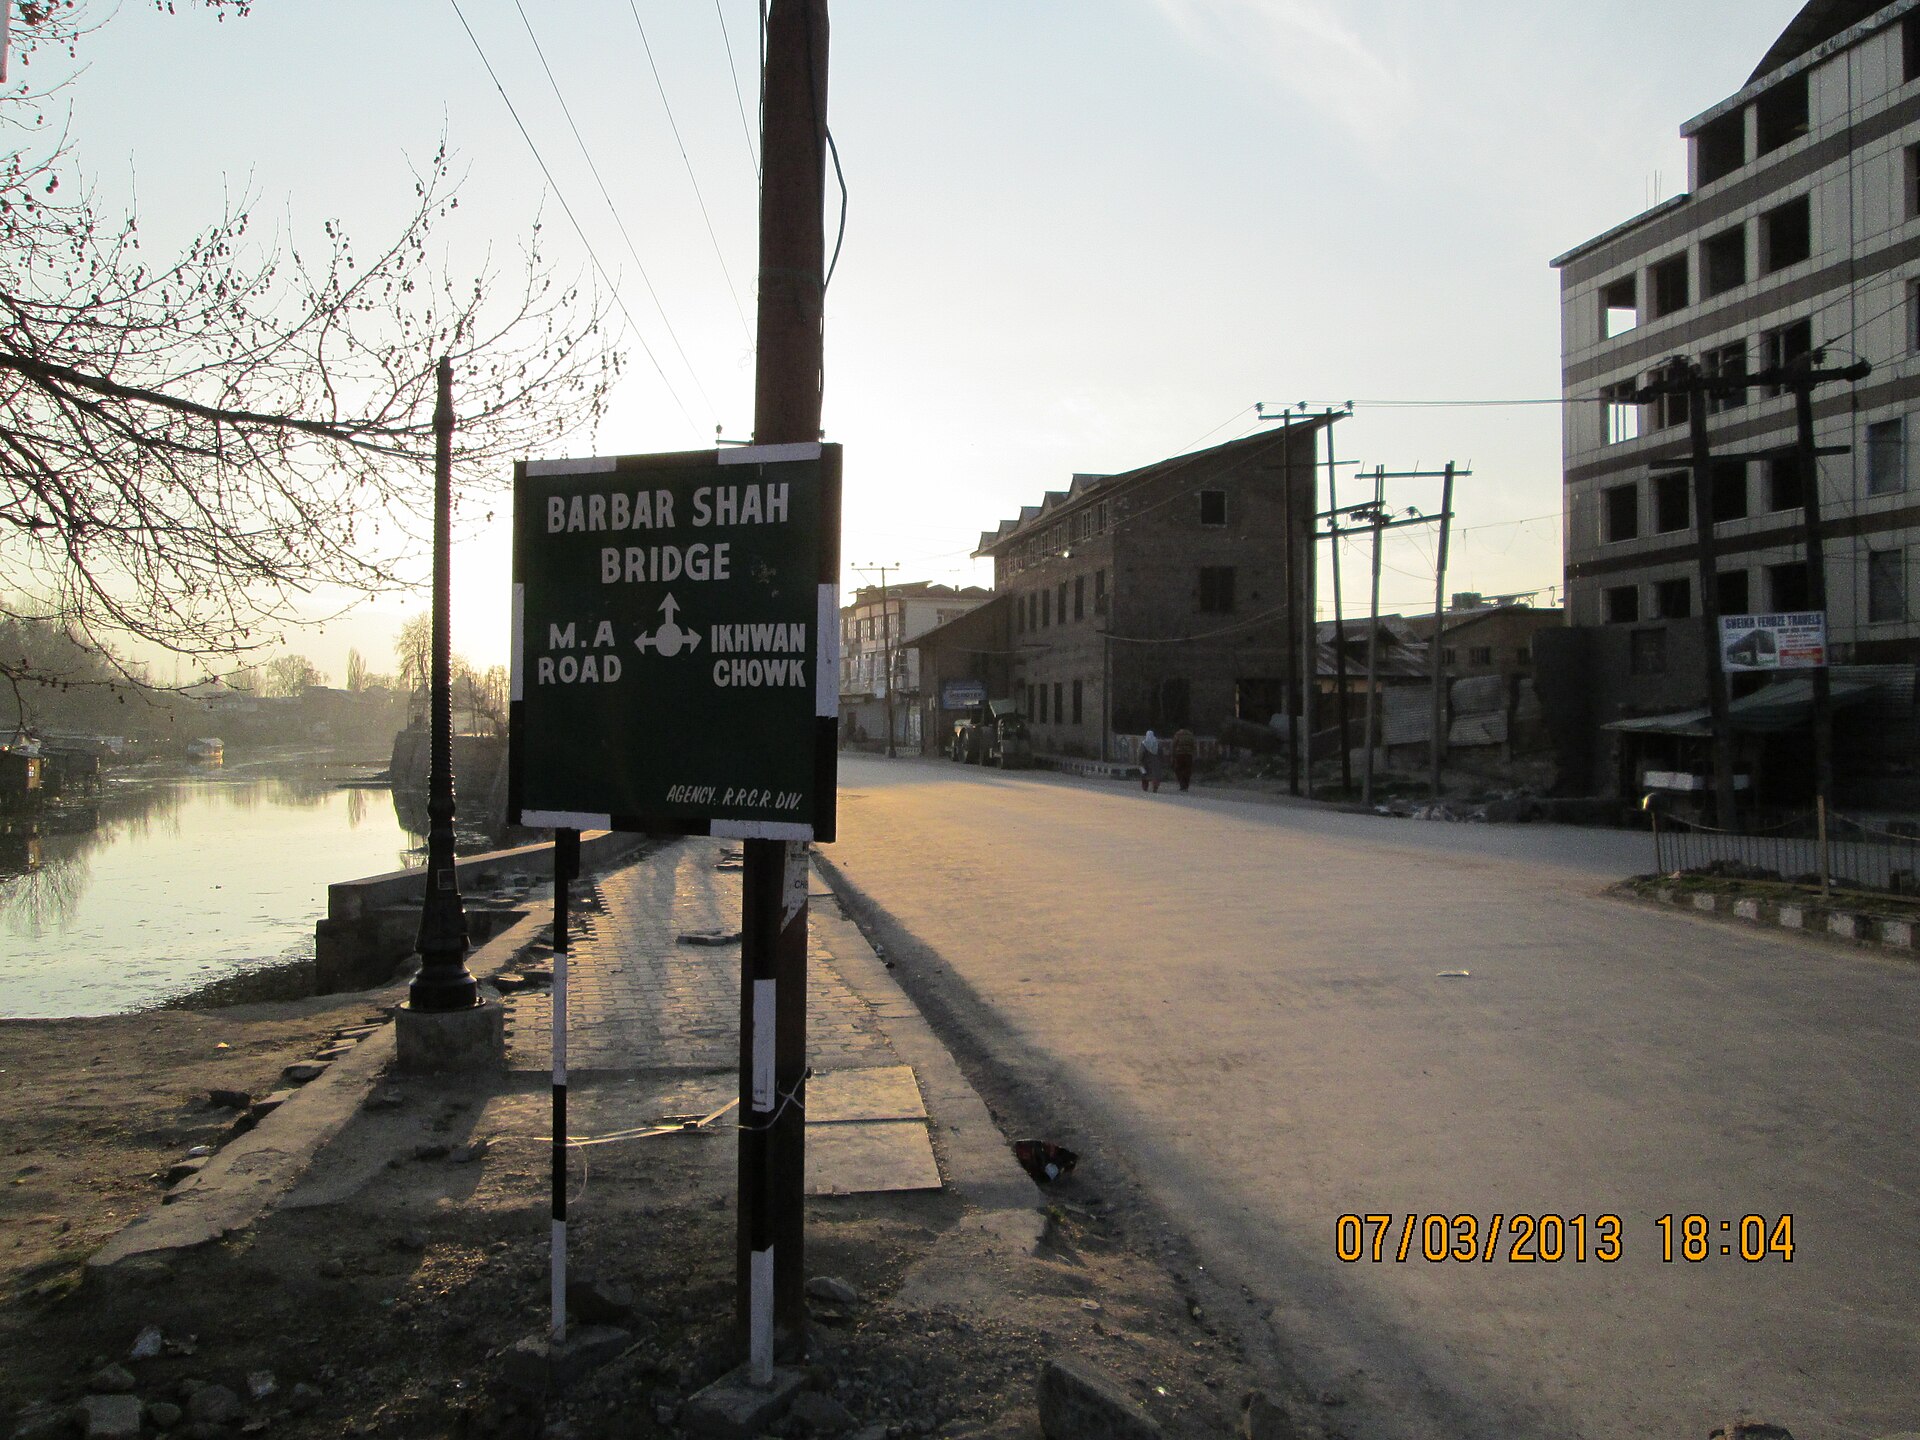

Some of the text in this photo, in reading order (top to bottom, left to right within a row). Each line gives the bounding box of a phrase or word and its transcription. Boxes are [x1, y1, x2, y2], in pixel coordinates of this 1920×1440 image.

[547, 482, 789, 534] BARBAR SHAH
[601, 543, 731, 584] BRIDGE
[1788, 613, 1822, 626] TRAVELS
[549, 620, 616, 650] M.A
[711, 623, 806, 653] IKHWAN
[538, 655, 622, 685] ROAD
[713, 659, 807, 688] CHOWK
